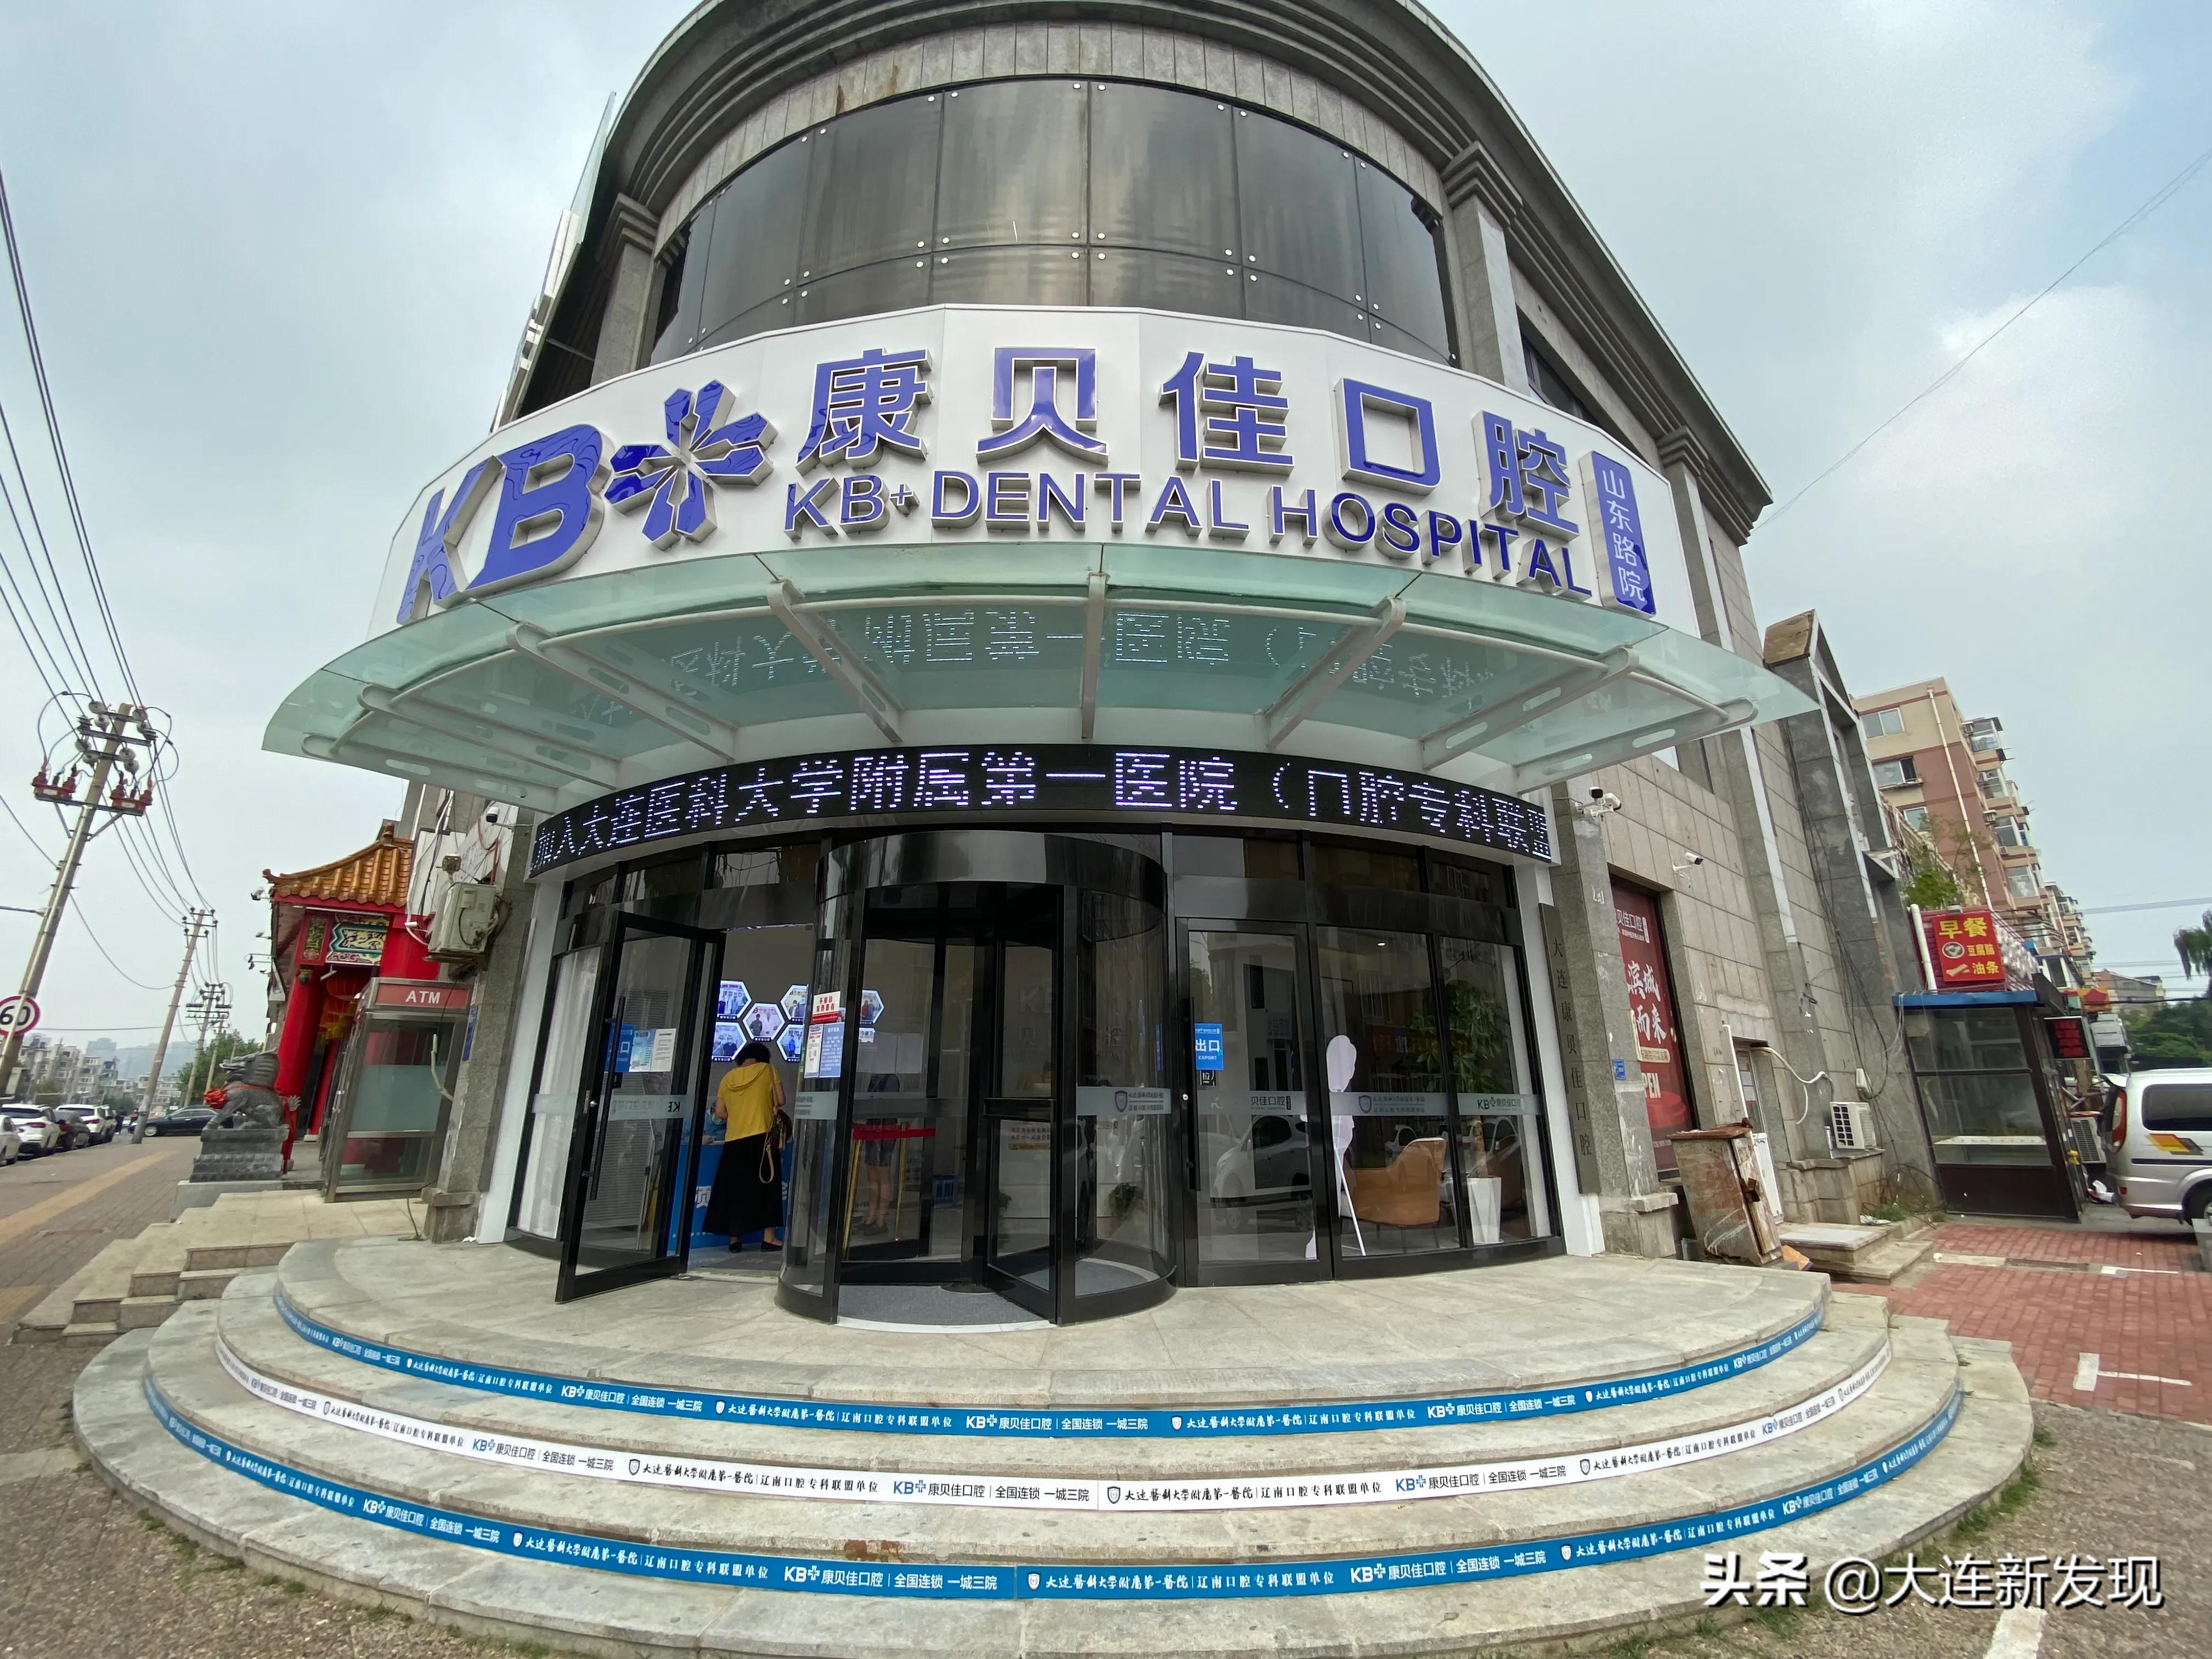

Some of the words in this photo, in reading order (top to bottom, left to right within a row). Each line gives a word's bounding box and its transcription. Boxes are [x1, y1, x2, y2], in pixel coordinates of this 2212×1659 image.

[796, 347, 1579, 542] 康贝佳口腔
[931, 470, 1250, 539] DENTAL
[1268, 486, 1593, 601] HOSPITAL
[1601, 469, 1648, 602] 山东路院
[1616, 909, 1644, 932] 贝佳口腔
[1939, 917, 1988, 940] 早餐
[1972, 961, 2000, 975] 油条
[1, 1005, 31, 1026] 60
[405, 990, 441, 1005] ATM
[1195, 1038, 1220, 1052] 出口
[1552, 936, 1593, 1156] 大连康贝佳口腔
[561, 1385, 578, 1398] KB
[584, 1389, 625, 1404] 康贝佳口腔
[631, 1394, 665, 1409] 全国连锁
[667, 1398, 703, 1412] 一城三院
[966, 1415, 986, 1429] KB
[998, 1417, 1052, 1430] 康贝佳口腔
[1061, 1418, 1103, 1430] 全国连锁
[1106, 1418, 1148, 1430] 一城三院
[1427, 1405, 1446, 1419] KB
[1457, 1402, 1503, 1417] 康贝佳口腔
[1509, 1398, 1543, 1412] 全国连锁
[1544, 1394, 1576, 1407] 一城三院
[472, 1438, 488, 1452] KB
[495, 1442, 535, 1460] 康贝佳口腔
[541, 1450, 576, 1466] 全国连锁
[578, 1455, 614, 1471] 一城三院
[893, 1480, 914, 1495] KB
[928, 1483, 985, 1499] 康贝佳口腔
[995, 1485, 1040, 1499] 全国连锁
[1044, 1488, 1090, 1502] 一城三院
[1395, 1477, 1416, 1492] KB
[1429, 1474, 1480, 1490] 康贝佳口腔
[1488, 1470, 1527, 1485] 全国连锁
[1530, 1465, 1567, 1479] 一城三院
[363, 1498, 380, 1514] KB
[385, 1505, 424, 1526] 康贝佳口腔
[430, 1517, 463, 1536] 全国连锁
[465, 1526, 500, 1543] 一城三院
[784, 1566, 808, 1583] KB
[821, 1569, 883, 1587] 康贝佳口腔
[894, 1573, 943, 1589] 全国连锁
[947, 1575, 997, 1590] 一城三院
[1350, 1566, 1374, 1583] KB
[1388, 1561, 1447, 1580] 康贝佳口腔
[1456, 1555, 1500, 1573] 全国连锁
[1504, 1550, 1547, 1567] 一城三院
[1782, 1500, 1796, 1515] KB
